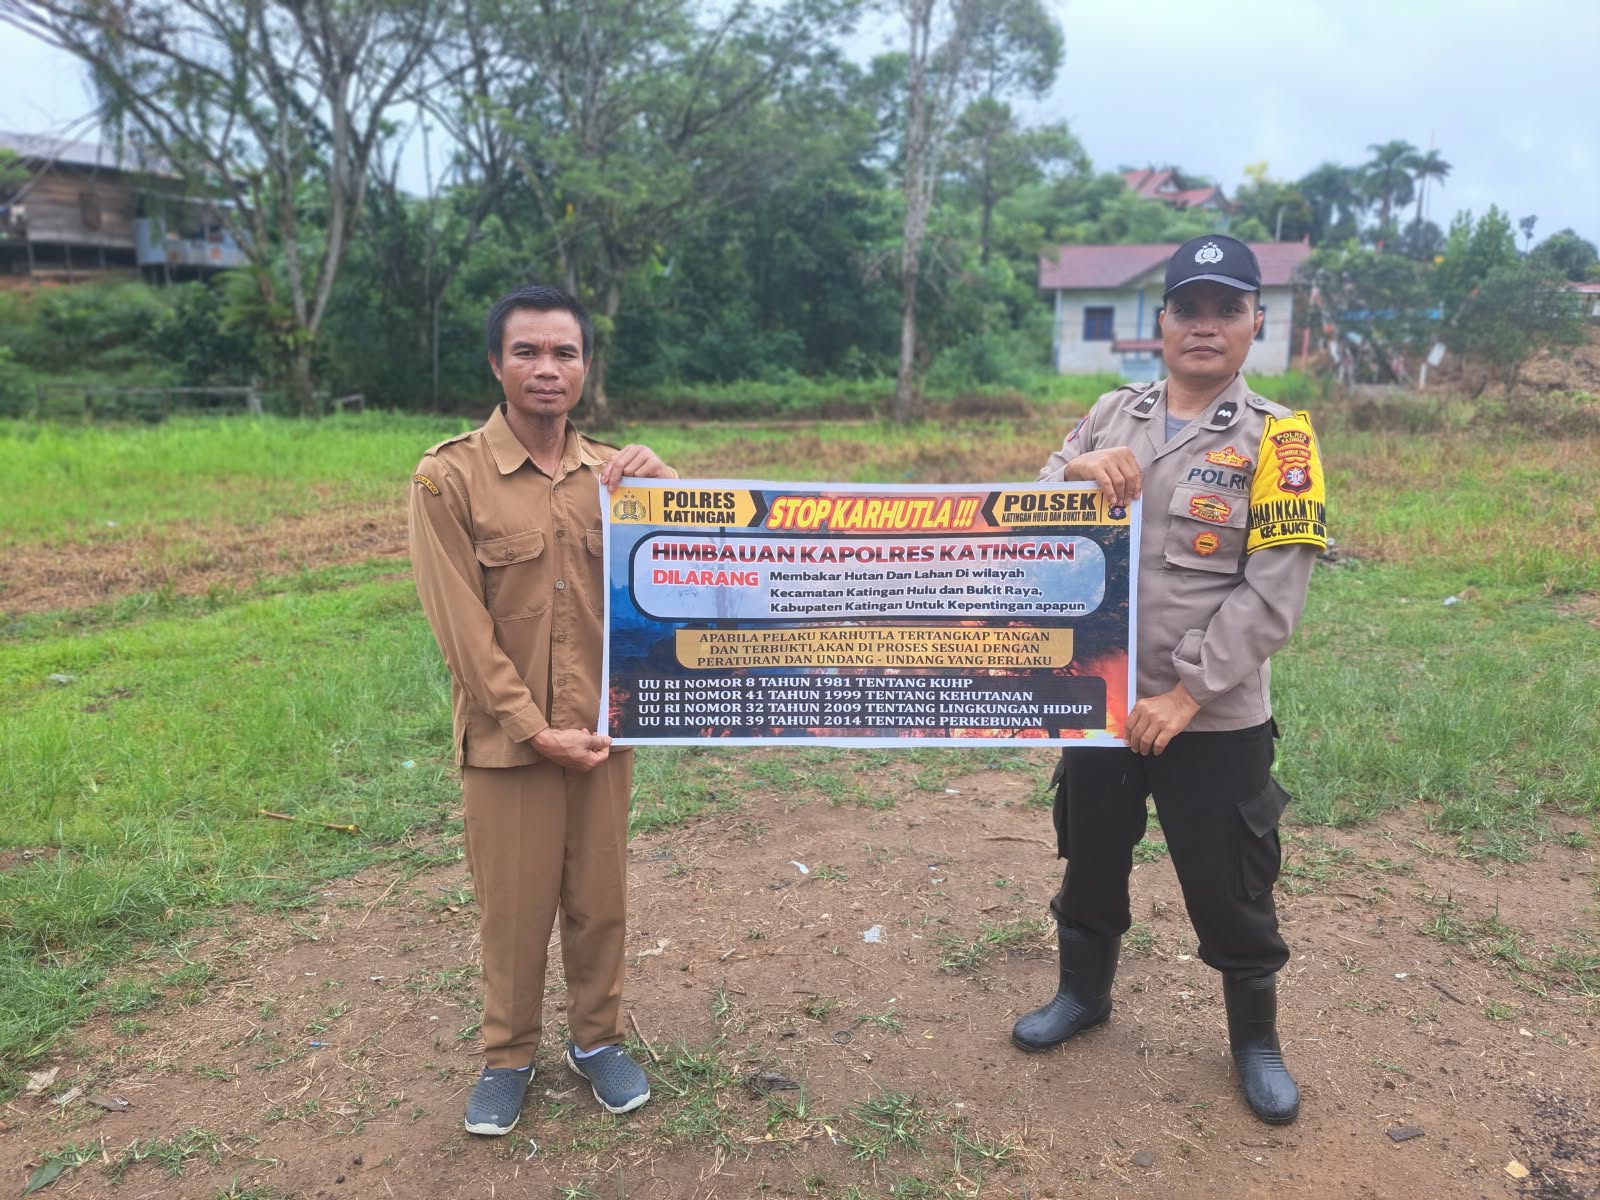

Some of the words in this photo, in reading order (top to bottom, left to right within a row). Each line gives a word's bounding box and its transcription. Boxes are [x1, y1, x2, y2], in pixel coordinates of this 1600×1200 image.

[1188, 468, 1246, 490] POLRI
[664, 491, 735, 508] POLRES
[1004, 493, 1097, 511] POLSEK
[664, 510, 735, 523] KATINGAN
[768, 498, 830, 529] STOP
[1002, 512, 1031, 523] KATINGAN
[1033, 512, 1048, 522] HULU
[1049, 512, 1061, 522] DAN
[1062, 511, 1080, 522] BUKIT
[1082, 511, 1097, 521] RAYA
[652, 543, 795, 563] HIMBAUAN
[801, 544, 934, 563] KAPOLRES
[940, 542, 1075, 561] KATINGAN
[653, 570, 759, 586] DILARANG
[770, 571, 842, 581] Membakar
[845, 570, 883, 581] Hutan
[887, 571, 911, 580] Dan
[914, 569, 952, 579] Lahan
[956, 569, 969, 578] Di
[972, 568, 1024, 580] wilayah
[770, 588, 843, 597] Kecamatan
[846, 587, 904, 598] Katingan
[907, 586, 936, 595] Hulu
[939, 585, 963, 595] dan
[966, 585, 1001, 595] Bukit
[1005, 586, 1043, 597] Raya,
[771, 602, 841, 614] Kabupaten
[845, 601, 902, 612] Katingan
[906, 600, 944, 610] Untuk
[948, 600, 1033, 612] Kepentingan
[1036, 602, 1085, 612] apapun
[700, 633, 757, 643] APABILA
[763, 633, 817, 641] PELAKU
[898, 631, 990, 641] TERTANGKAP
[994, 632, 1049, 641] TANGAN
[710, 645, 739, 654] DAN
[858, 643, 872, 652] DI
[877, 643, 928, 652] PROSES
[932, 644, 978, 653] SESUAI
[983, 644, 1040, 653] DENGAN
[697, 657, 779, 667] PERATURAN
[784, 656, 813, 664] DAN
[817, 655, 874, 664] UNDANG
[886, 655, 943, 665] UNDANG
[947, 656, 984, 665] YANG
[988, 656, 1052, 665] BERLAKU
[639, 680, 660, 689] UU
[664, 680, 680, 689] RI
[684, 679, 741, 688] NOMOR
[745, 678, 755, 687] 8
[759, 678, 810, 687] TAHUN
[815, 678, 850, 687] 1981
[855, 678, 926, 687] TENTANG
[930, 678, 973, 688] KUHP
[639, 692, 660, 702] UU
[664, 692, 680, 701] RI
[684, 691, 742, 701] NOMOR
[745, 691, 764, 700] 41
[768, 690, 820, 700] TAHUN
[824, 691, 861, 700] 1999
[865, 691, 936, 700] TENTANG
[939, 691, 1033, 701] KEHUTANAN
[639, 705, 660, 714] UU
[664, 704, 680, 713] RI
[684, 704, 742, 713] NOMOR
[745, 703, 764, 713] 32
[768, 703, 820, 713] TAHUN
[824, 703, 861, 713] 2009
[865, 703, 936, 713] TENTANG
[939, 704, 1039, 714] LINGKUNGAN
[1043, 705, 1092, 714] HIDUP
[639, 717, 660, 726] UU
[664, 717, 680, 726] RI
[684, 716, 742, 726] NOMOR
[745, 716, 764, 726] 39
[768, 716, 820, 725] TAHUN
[824, 716, 861, 725] 2014
[865, 716, 936, 726] TENTANG
[939, 716, 1043, 727] PERKEBUNAN
